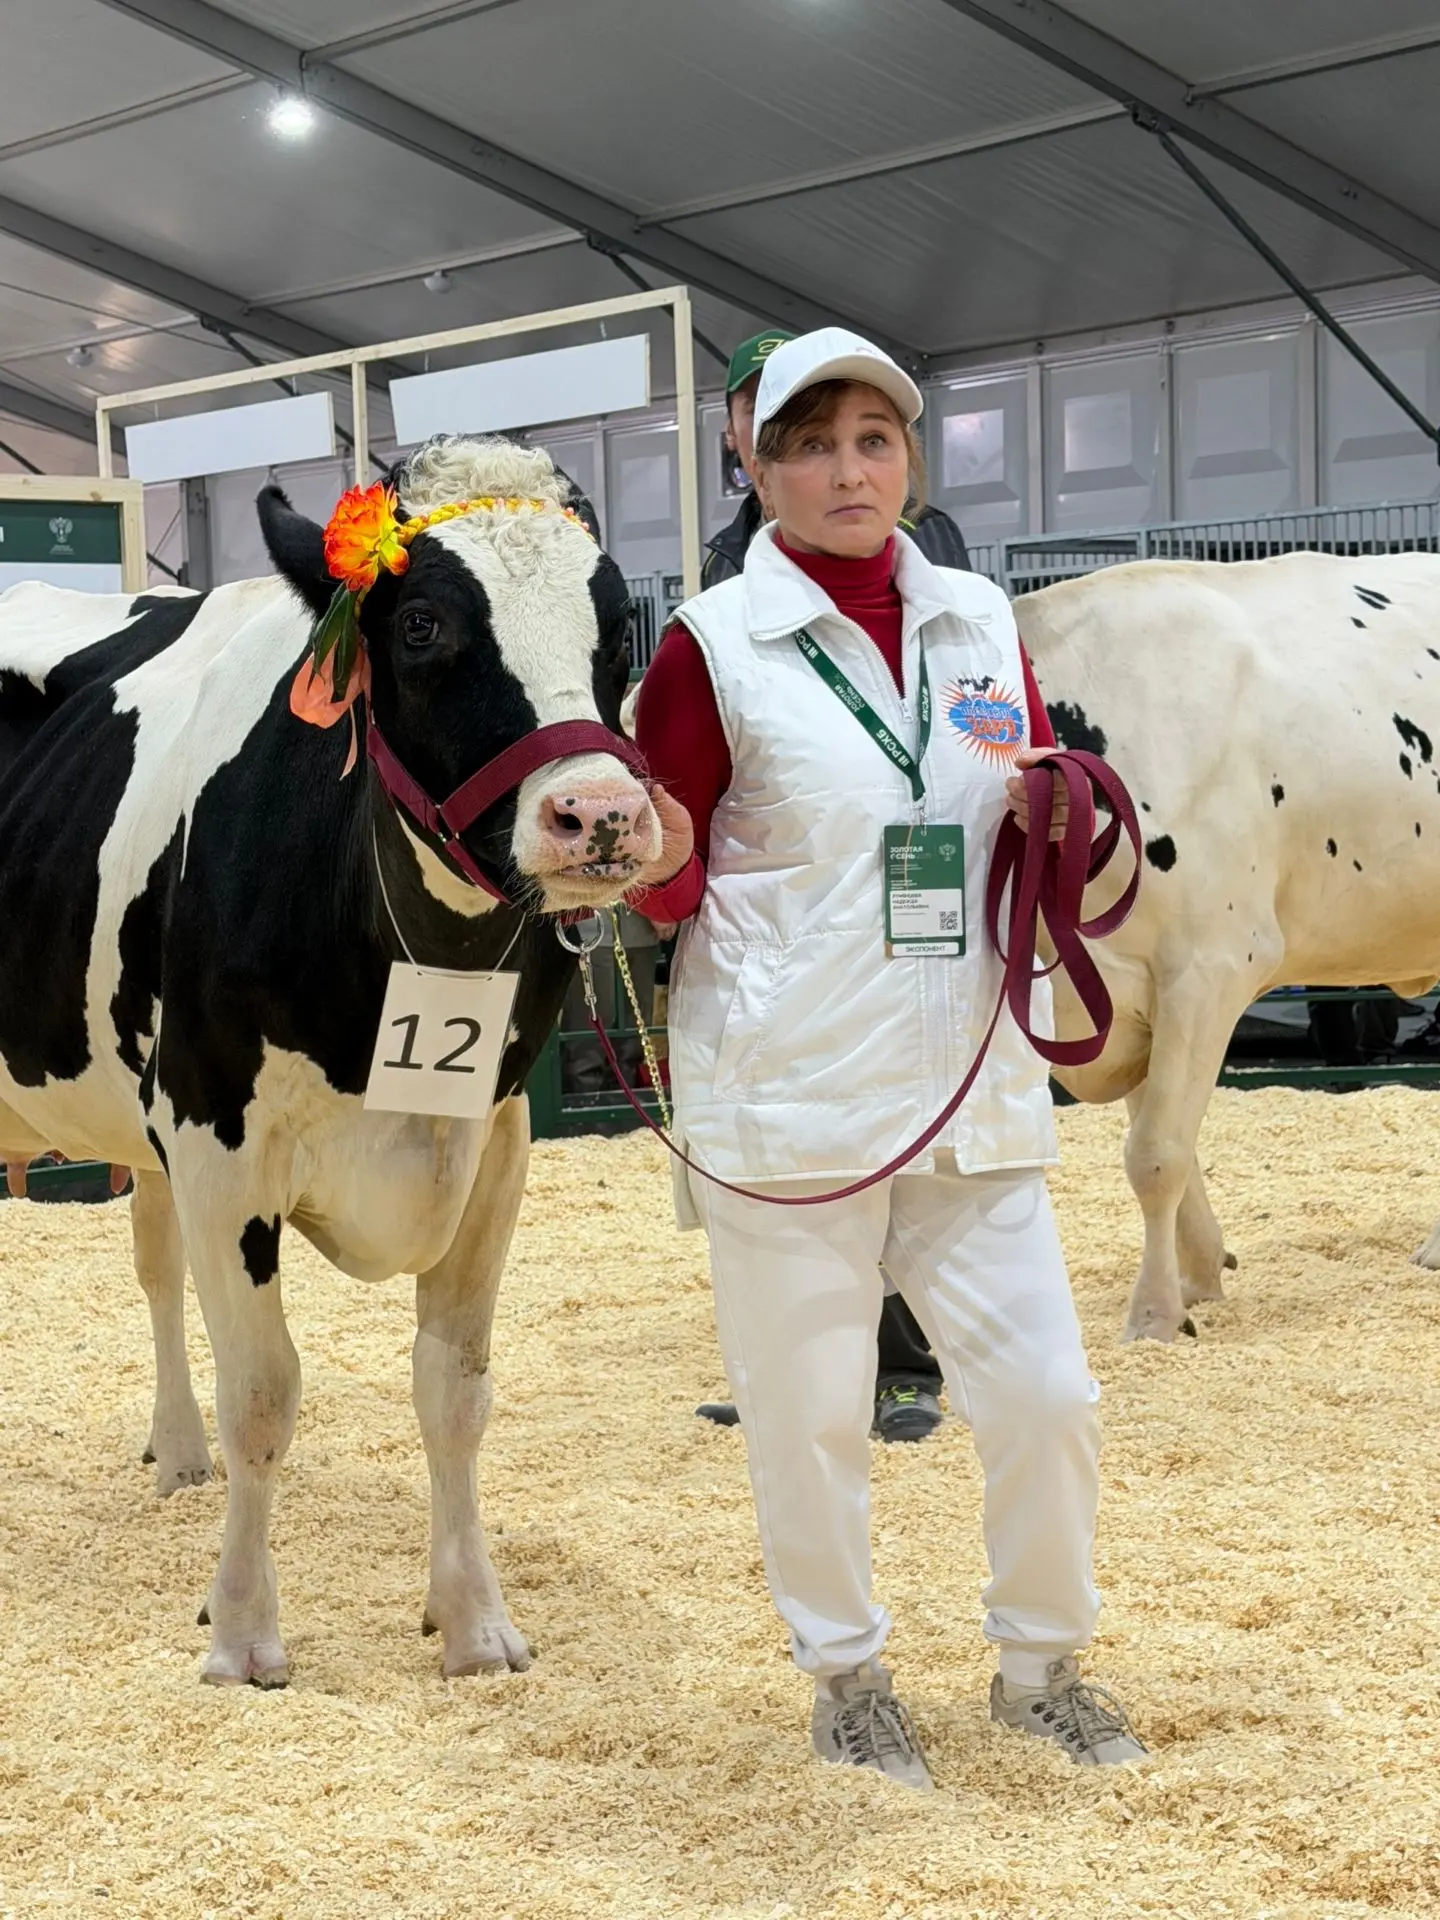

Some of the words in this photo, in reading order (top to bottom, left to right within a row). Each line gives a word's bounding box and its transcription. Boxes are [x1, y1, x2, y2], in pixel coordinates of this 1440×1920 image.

[794, 629, 809, 650] РСХ
[834, 684, 860, 713] ЗОЛОТАЯ
[876, 729, 902, 760] РСХБ
[905, 945, 946, 953] ЭКСПОНЕНТ
[383, 1013, 482, 1074] 12
